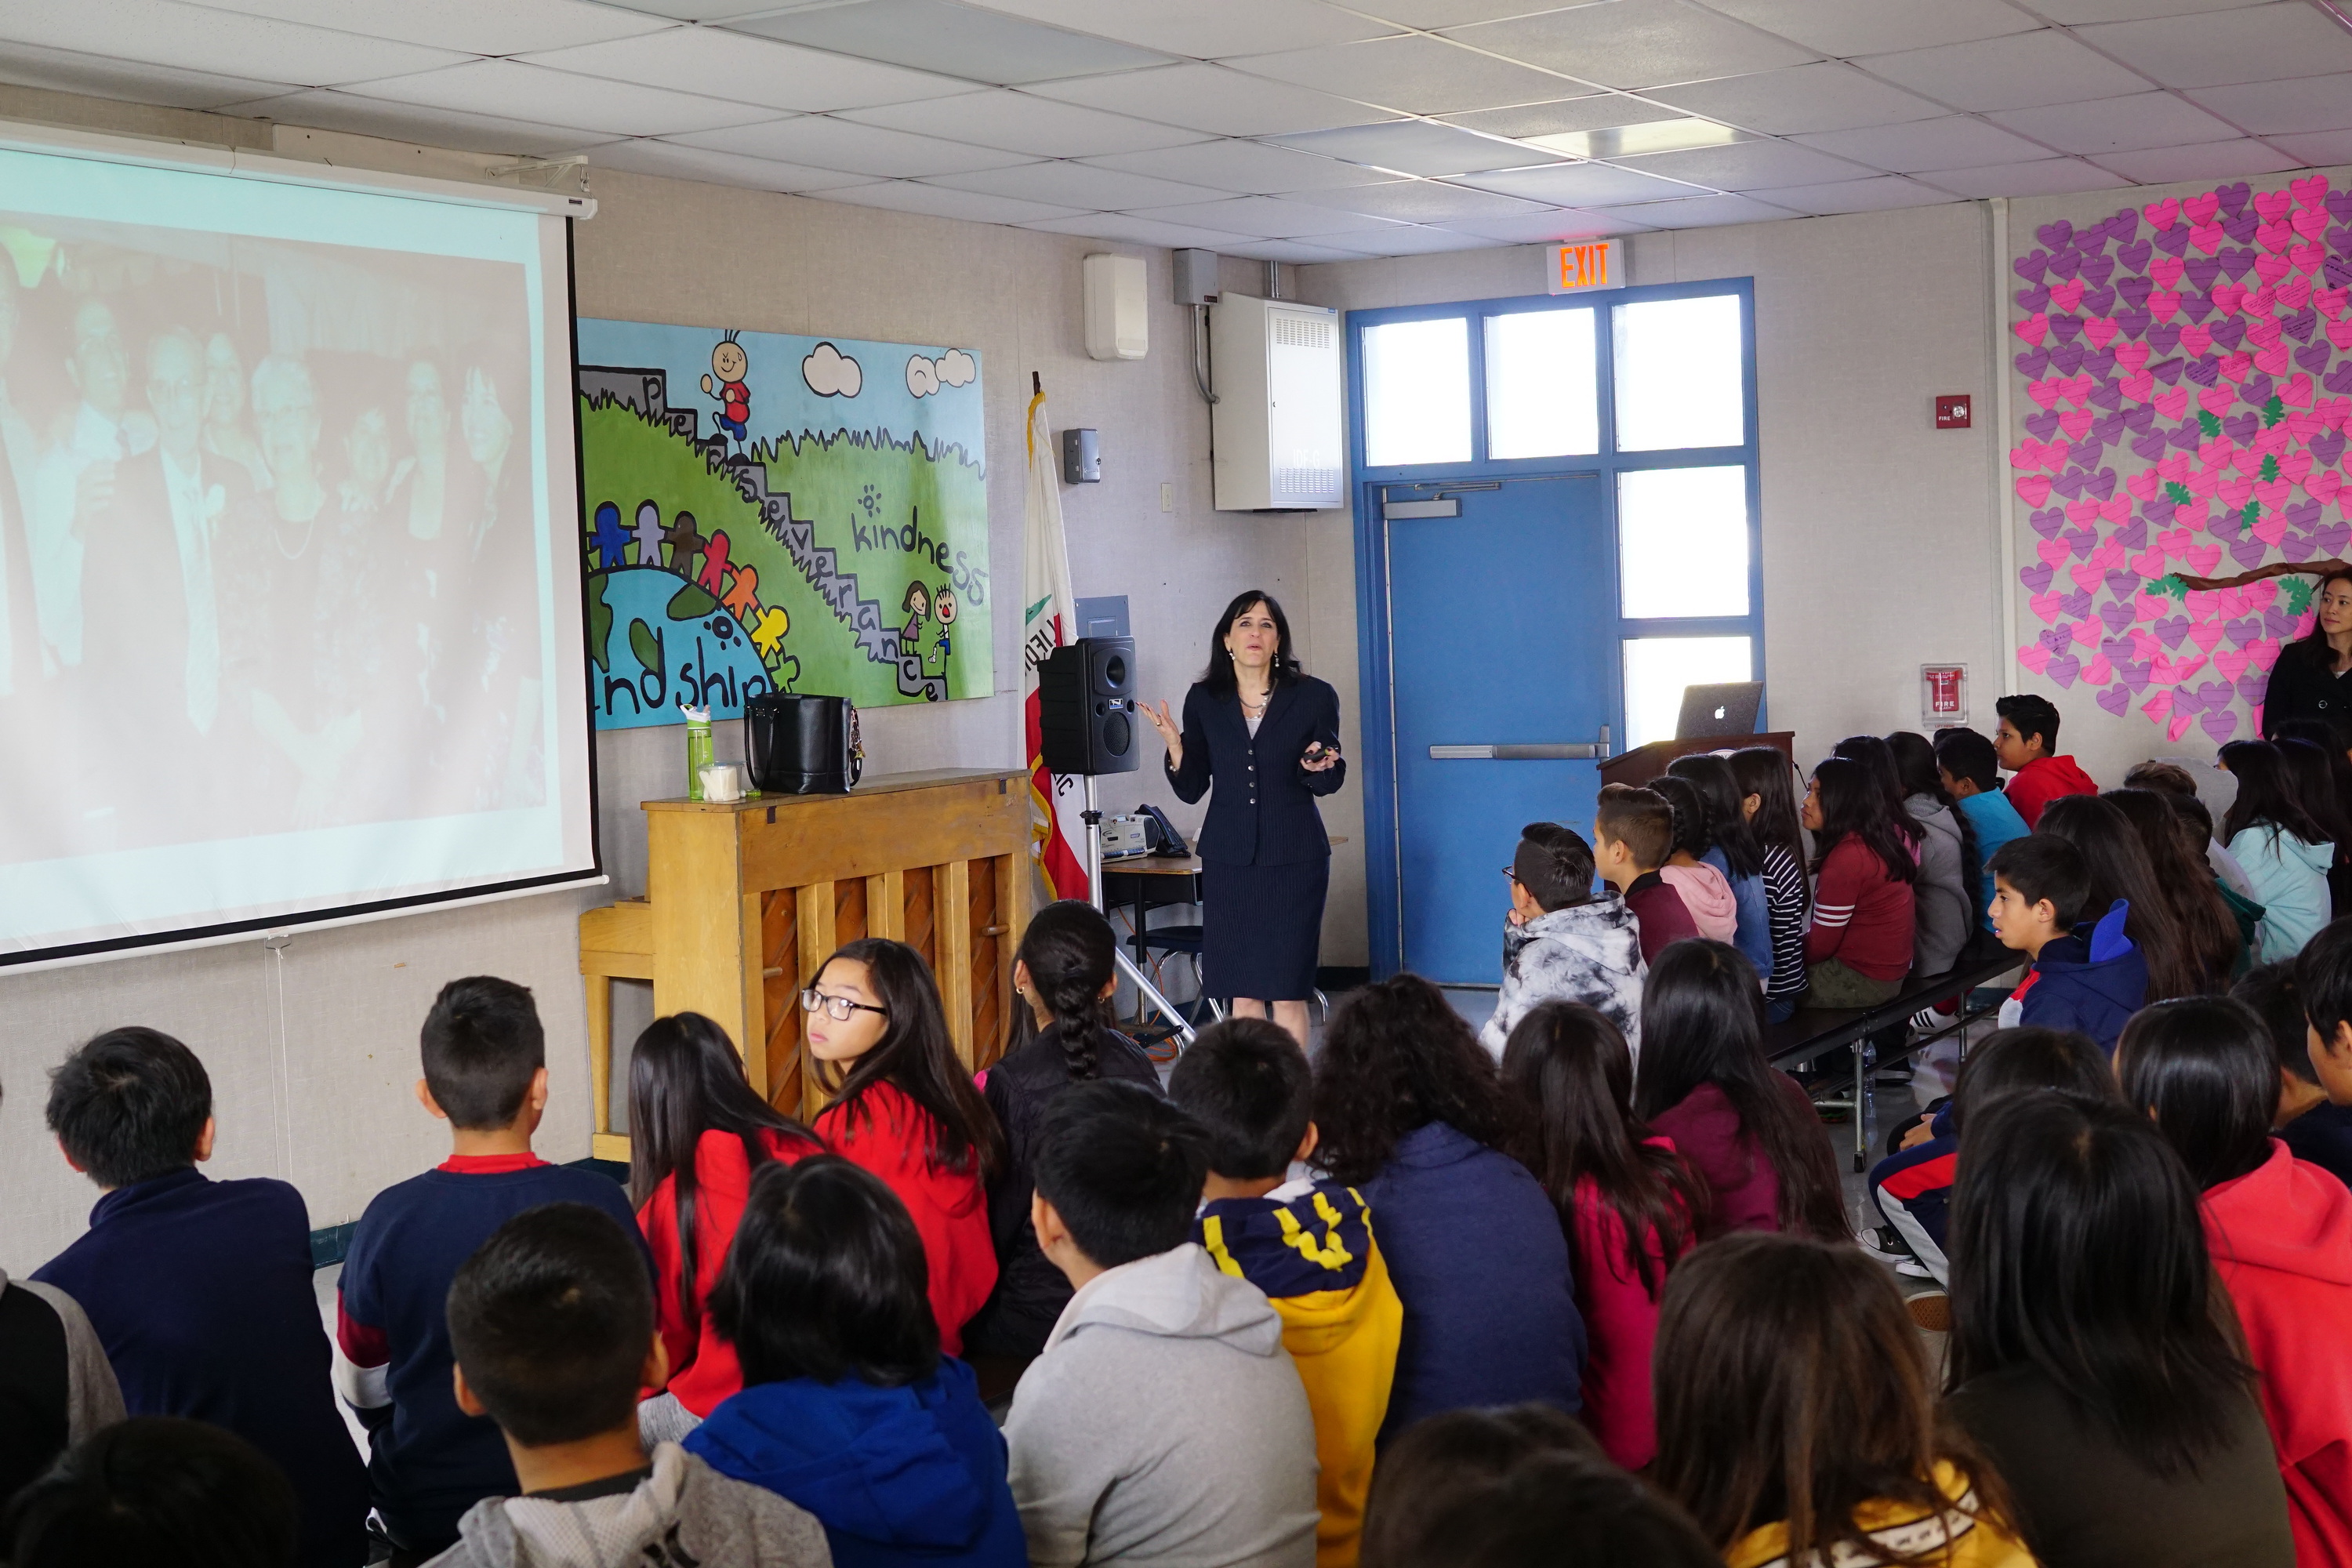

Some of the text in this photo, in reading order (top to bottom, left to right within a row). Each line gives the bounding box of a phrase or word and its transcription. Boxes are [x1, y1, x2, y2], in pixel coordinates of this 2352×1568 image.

[1559, 242, 1610, 289] EXIT
[1293, 448, 1320, 468] IDF-G
[851, 505, 989, 607] kindness
[594, 626, 768, 716] ndship
